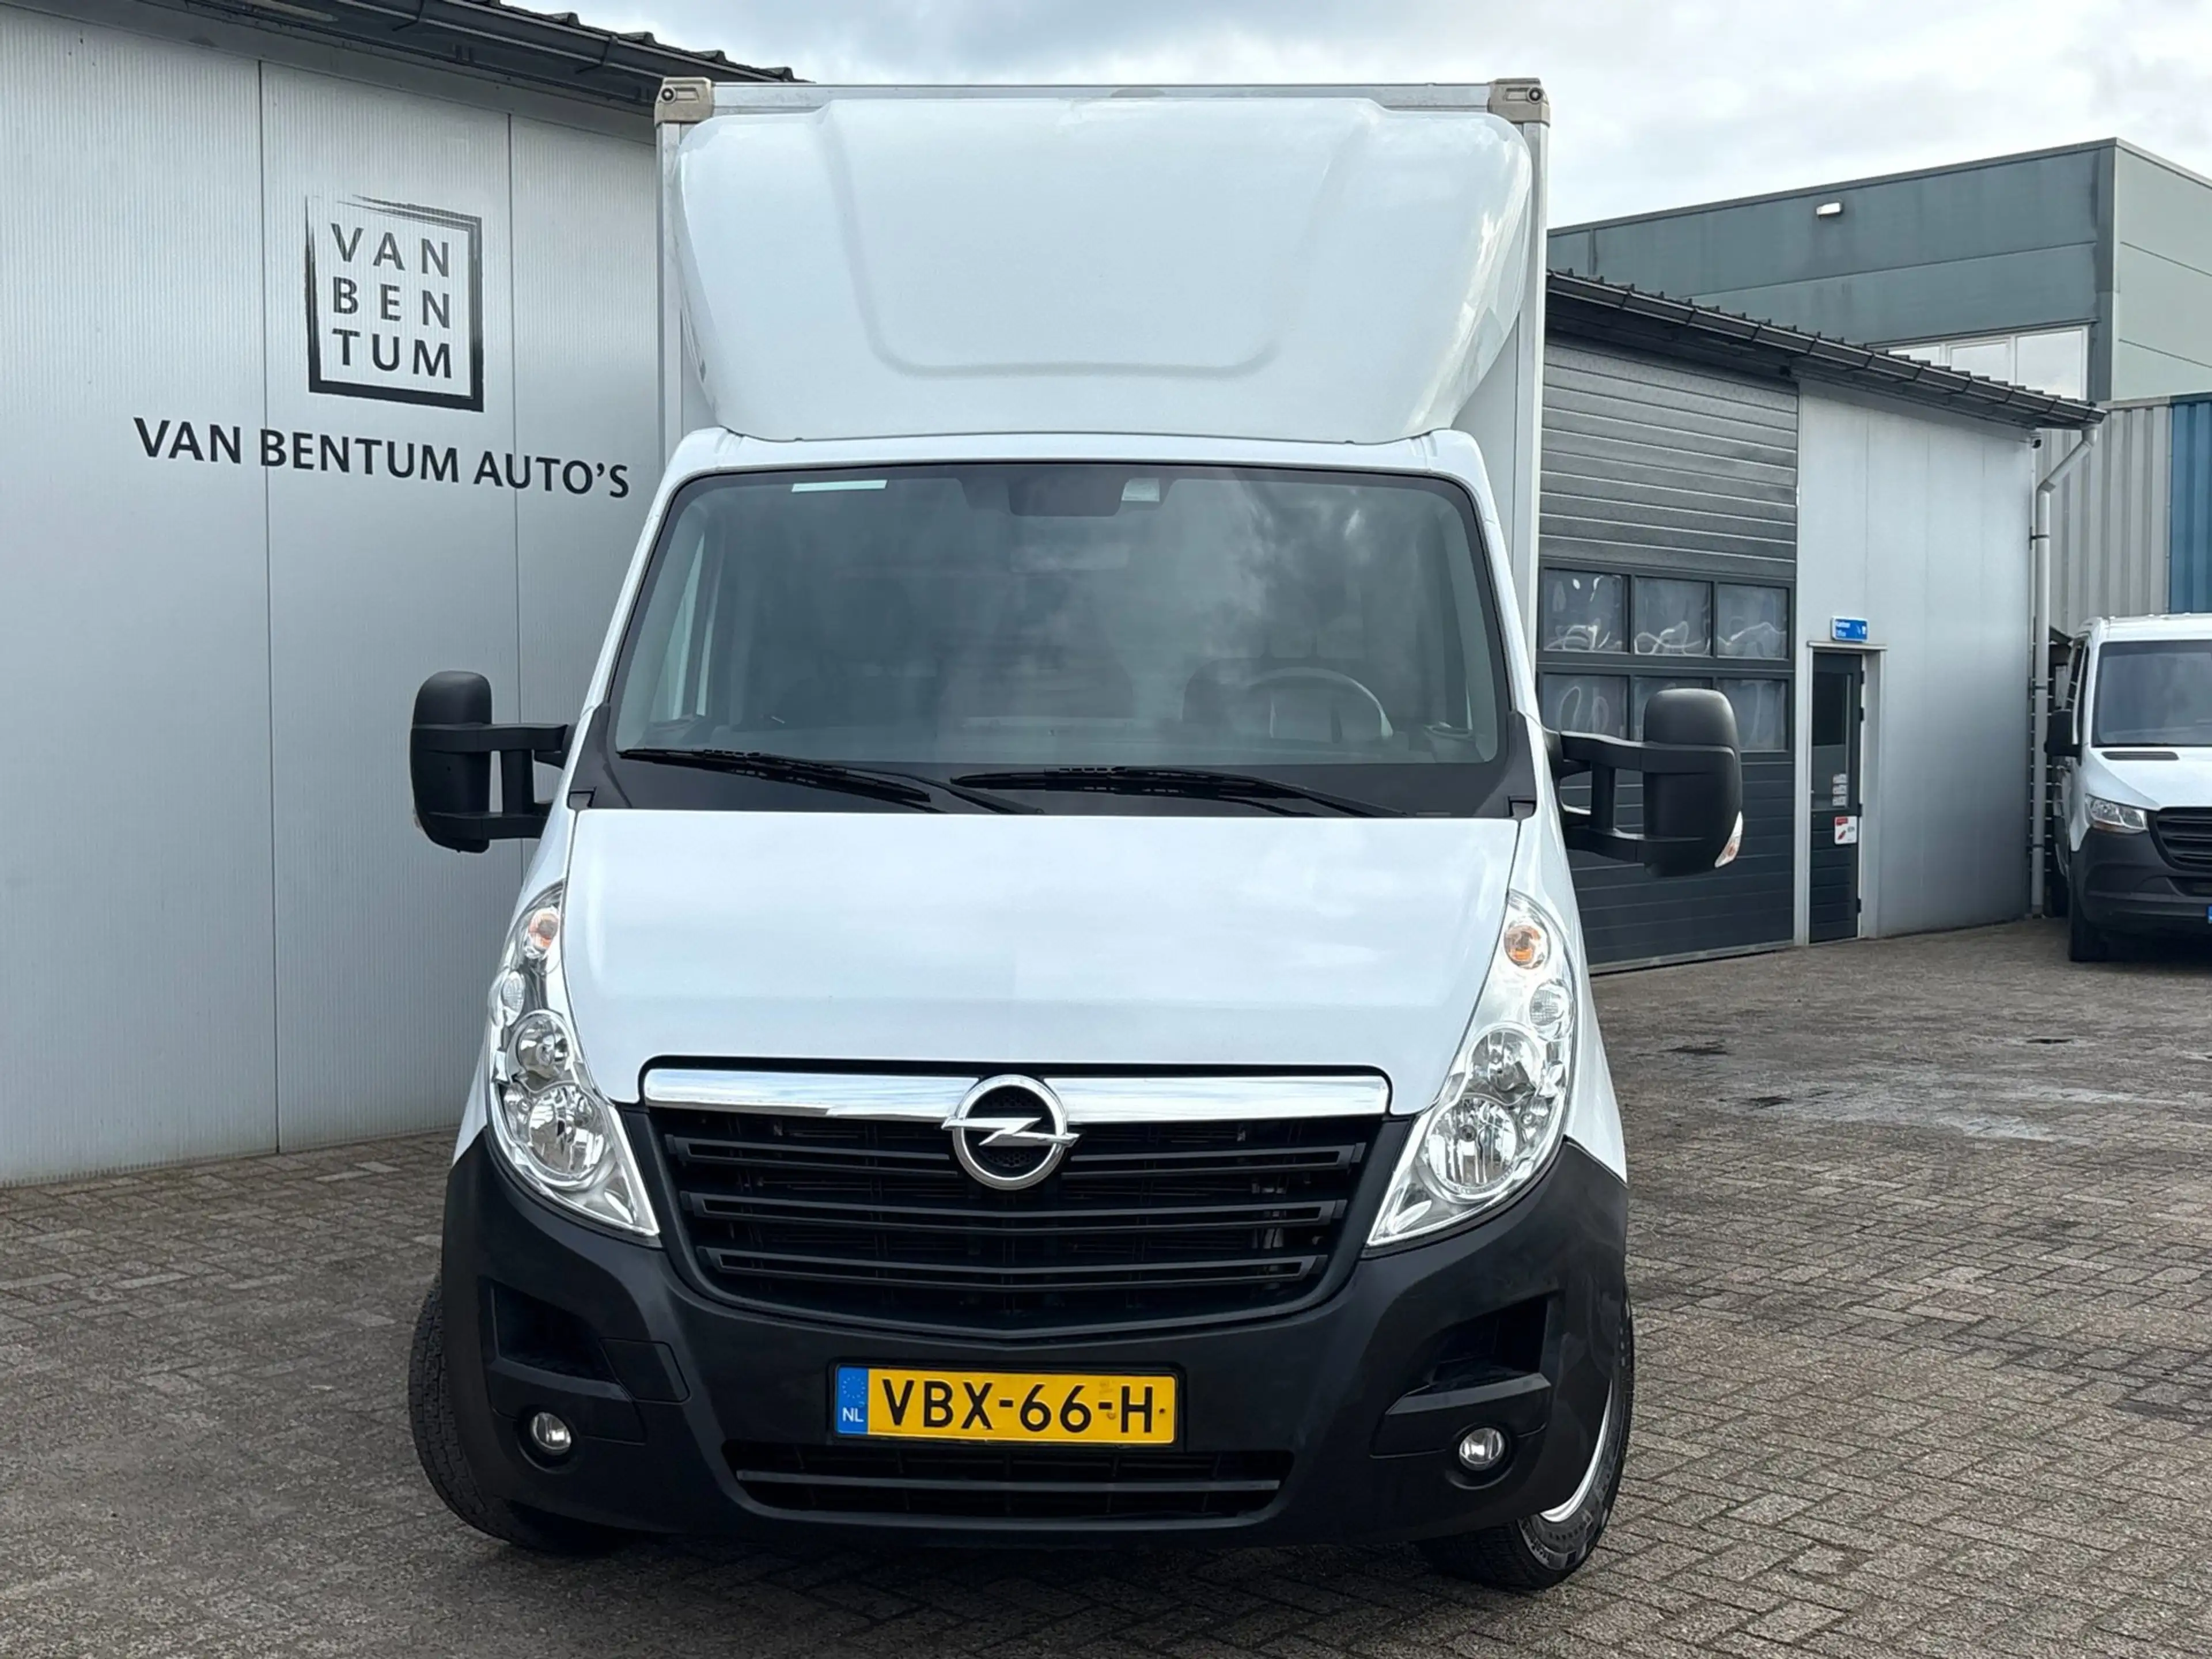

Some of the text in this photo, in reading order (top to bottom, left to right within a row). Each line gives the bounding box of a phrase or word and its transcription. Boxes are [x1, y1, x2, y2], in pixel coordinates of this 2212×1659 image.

[330, 222, 450, 278] VAN
[331, 276, 450, 329] BEN
[331, 327, 452, 380] TUM
[134, 417, 630, 499] VAN BENTUM AUTO'S
[842, 1407, 864, 1423] NL
[881, 1378, 1153, 1434] VBX-66-H
